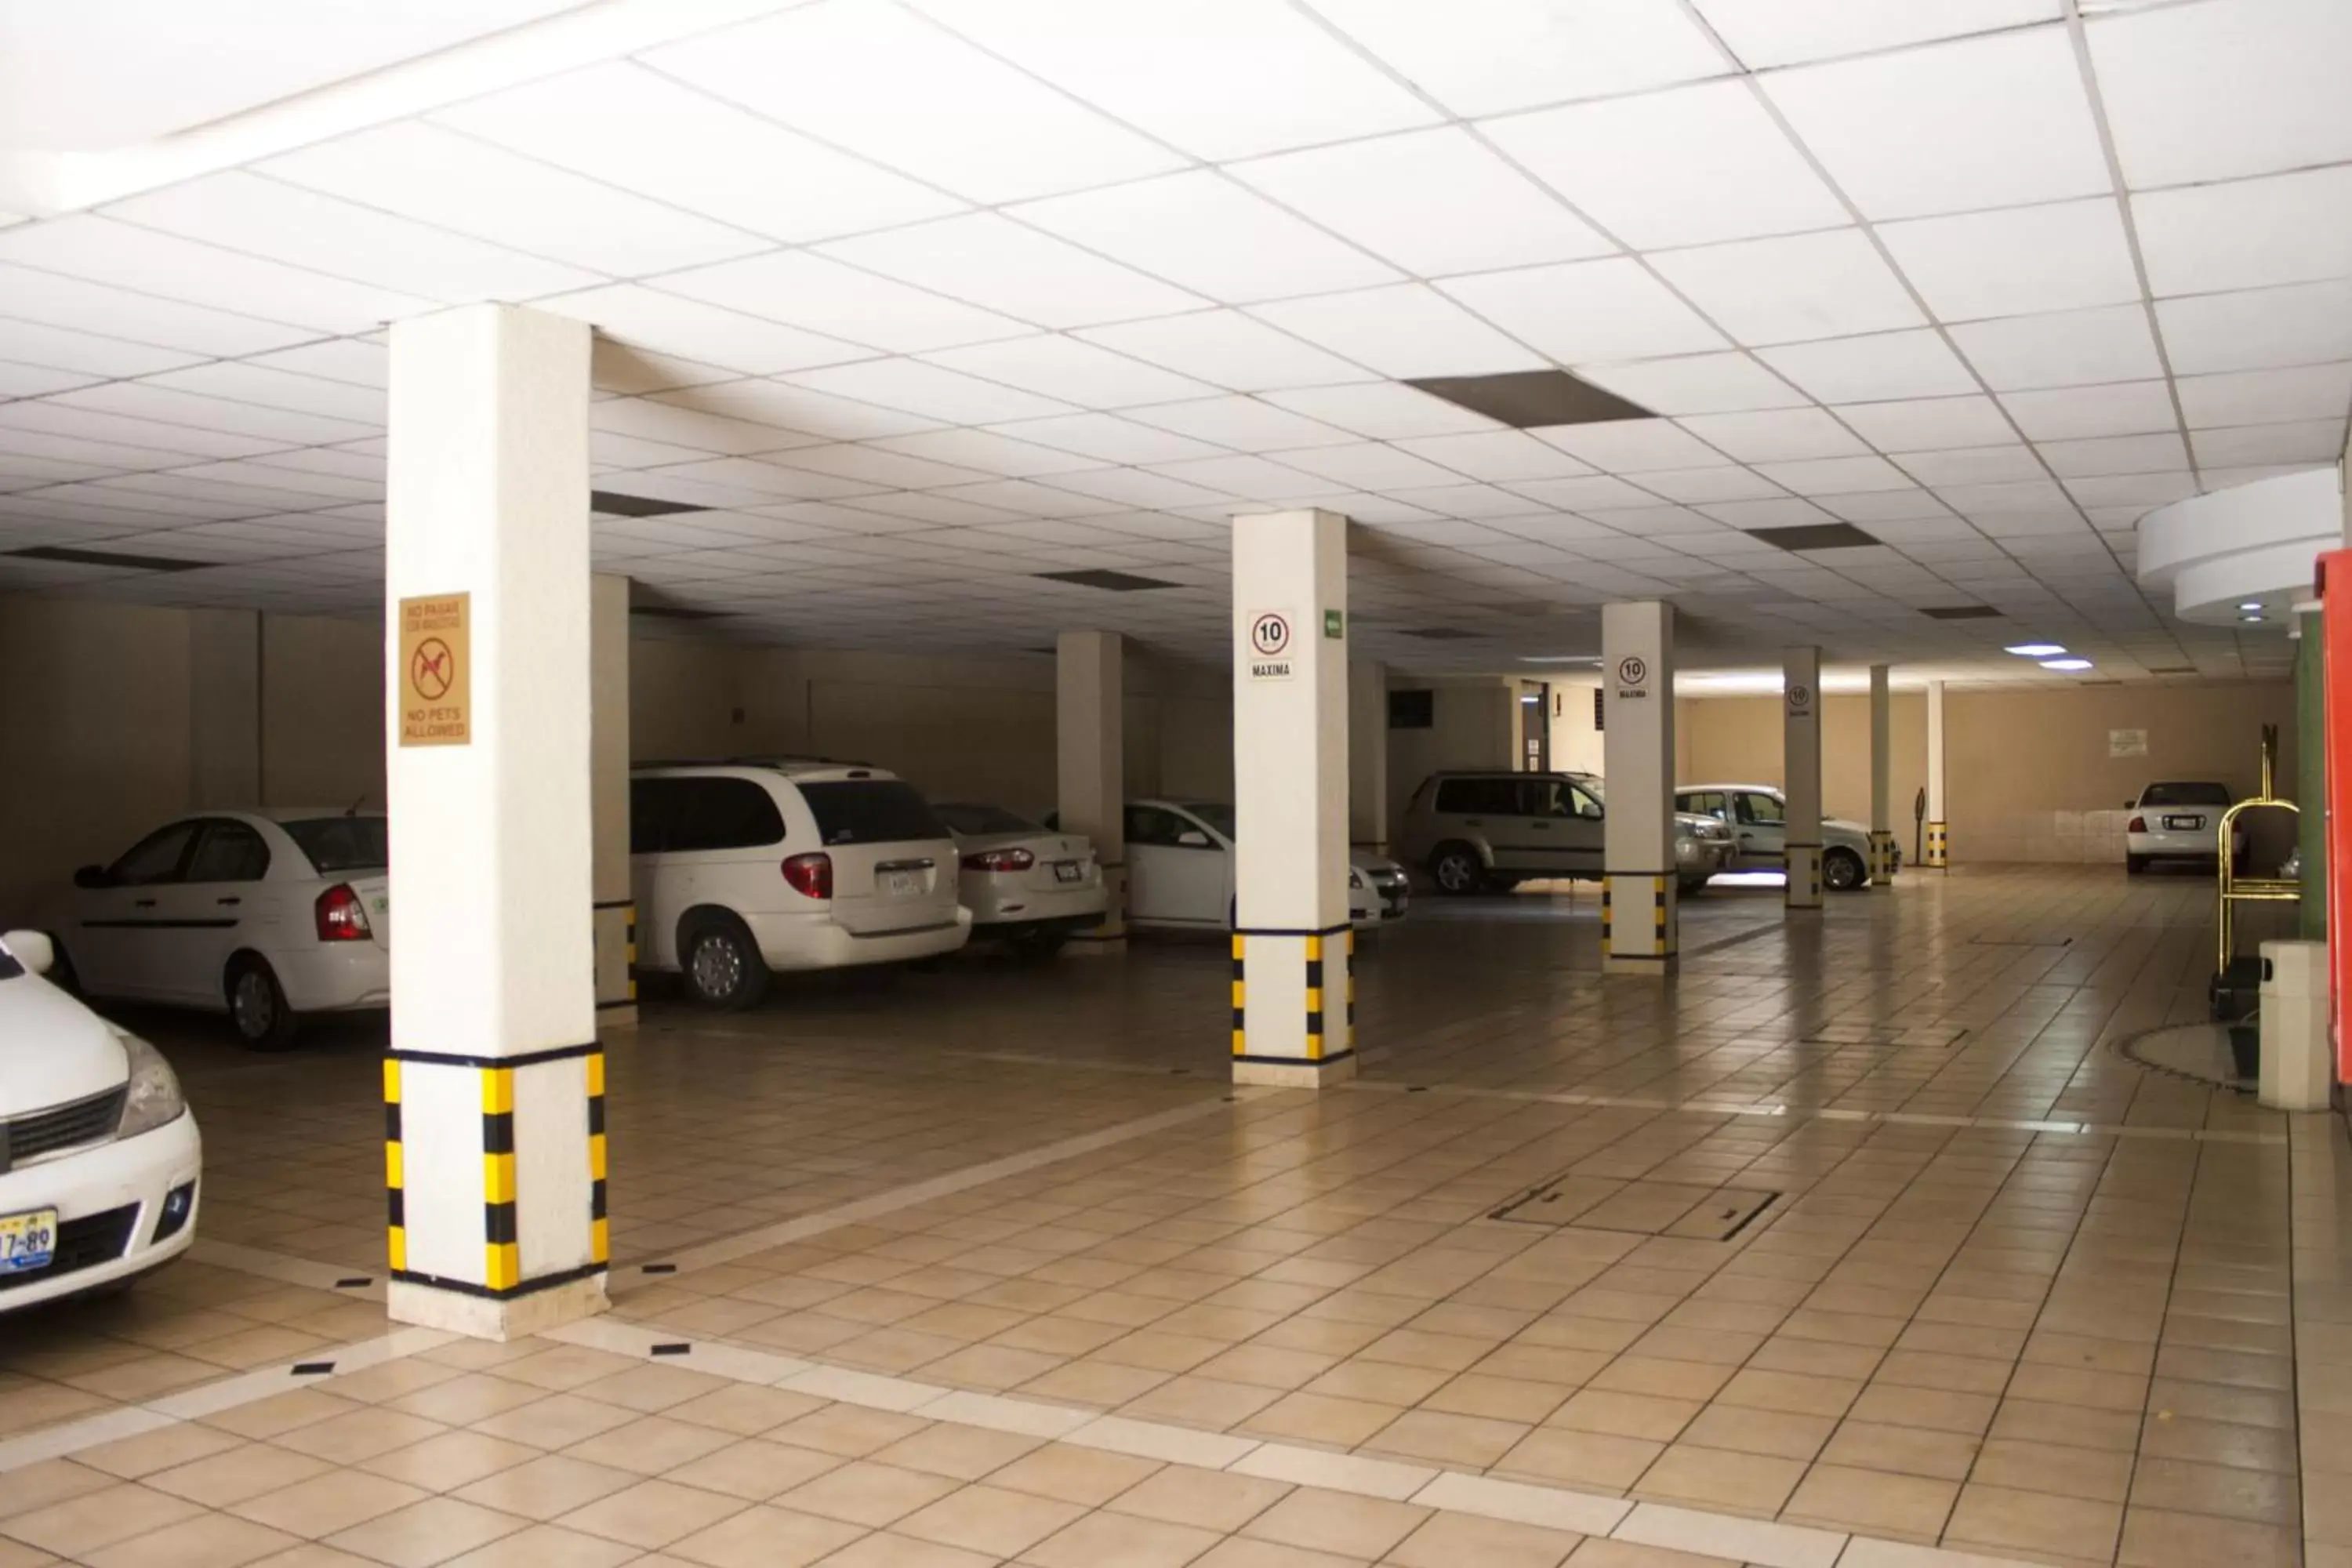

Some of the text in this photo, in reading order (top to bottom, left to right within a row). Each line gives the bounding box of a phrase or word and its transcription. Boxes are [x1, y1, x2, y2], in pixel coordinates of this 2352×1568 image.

[407, 605, 423, 618] NO
[1260, 622, 1281, 641] 10
[1253, 663, 1290, 677] MAXIMA
[1626, 662, 1641, 676] 10
[407, 707, 460, 721] NO PETS
[405, 723, 465, 737] ALLOWED
